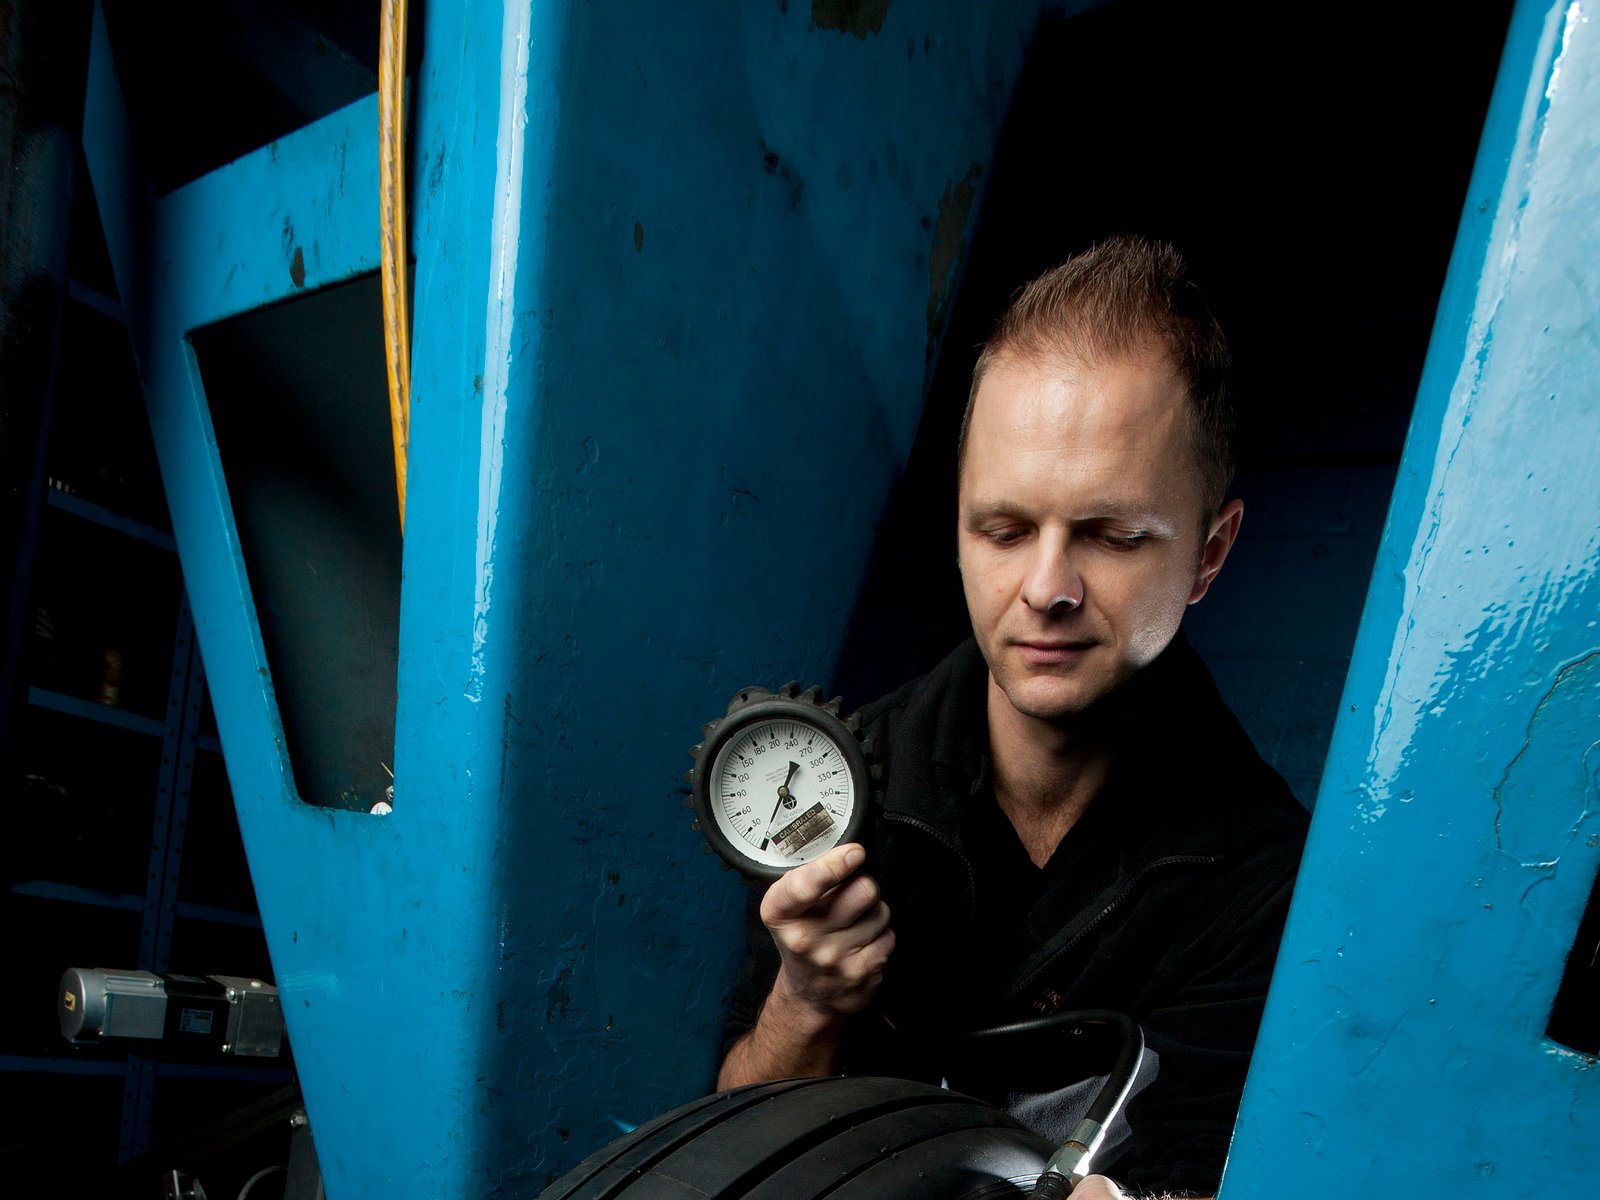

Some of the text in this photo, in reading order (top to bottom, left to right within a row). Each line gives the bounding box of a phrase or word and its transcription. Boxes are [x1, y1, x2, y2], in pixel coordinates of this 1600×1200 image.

[768, 738, 781, 749] 210
[784, 738, 799, 751] 240
[753, 745, 766, 756] 180
[799, 746, 813, 758] 270
[742, 757, 755, 769] 150
[809, 757, 825, 769] 300
[738, 772, 750, 783] 120
[816, 771, 832, 783] 330
[736, 789, 747, 798] 90
[818, 787, 834, 799] 360
[741, 805, 752, 815] 60
[751, 817, 762, 828] 30
[779, 809, 816, 839] CALIBRATED
